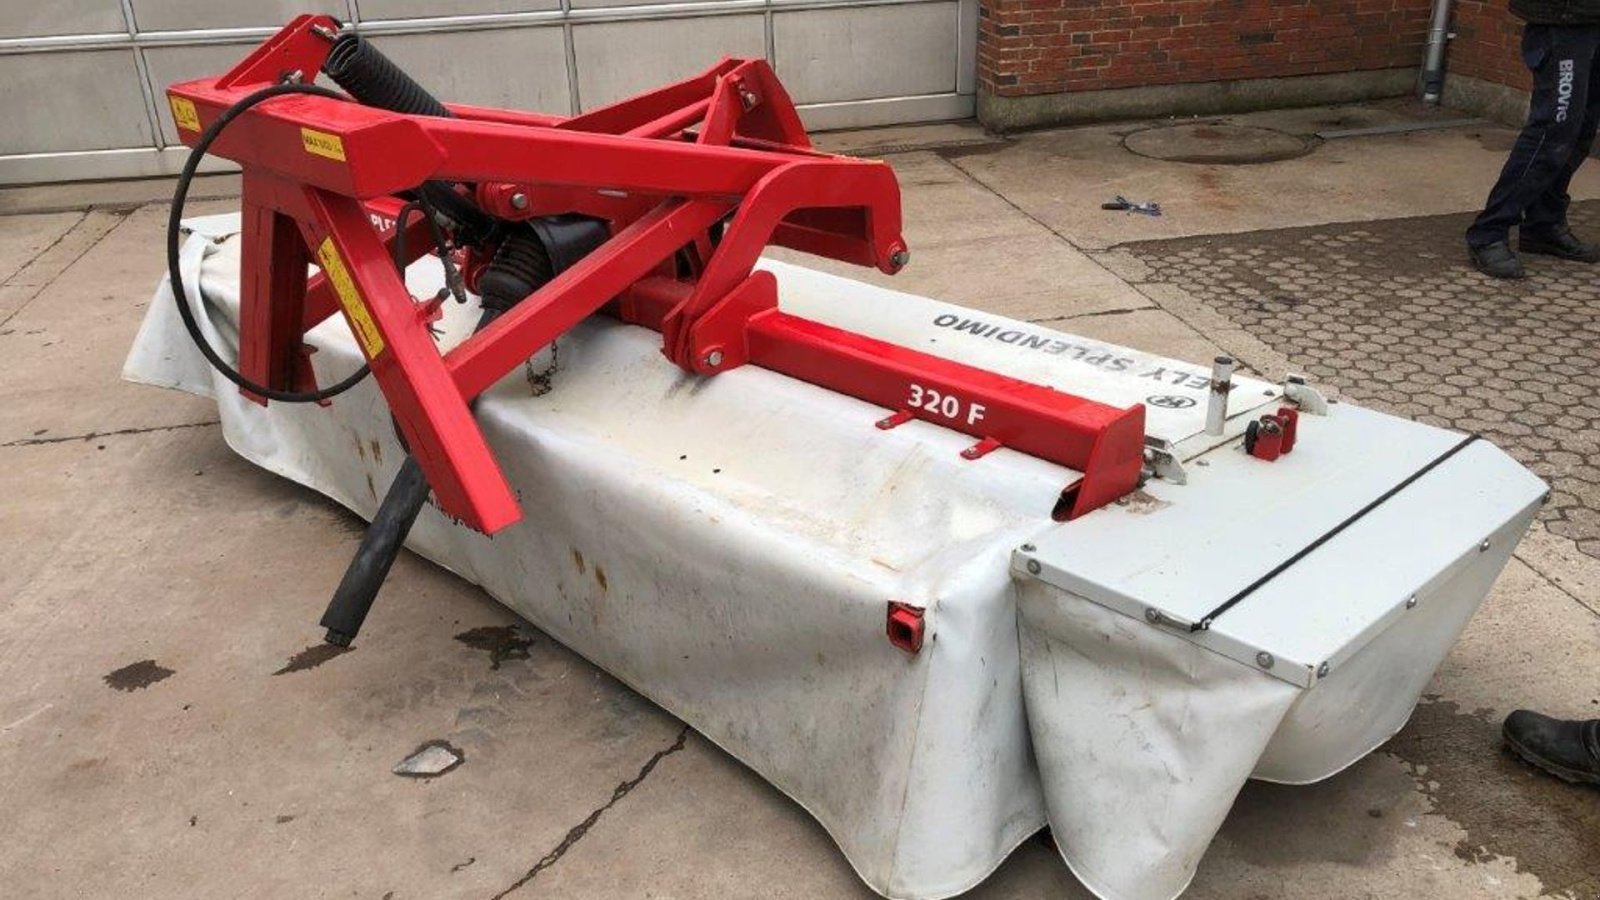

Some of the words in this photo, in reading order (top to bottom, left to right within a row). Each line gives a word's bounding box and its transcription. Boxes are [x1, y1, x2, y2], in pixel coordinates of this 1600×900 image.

[933, 313, 1136, 372] SPLENDIMO
[1138, 367, 1239, 391] ELY
[907, 383, 959, 418] 320
[967, 403, 986, 425] F
